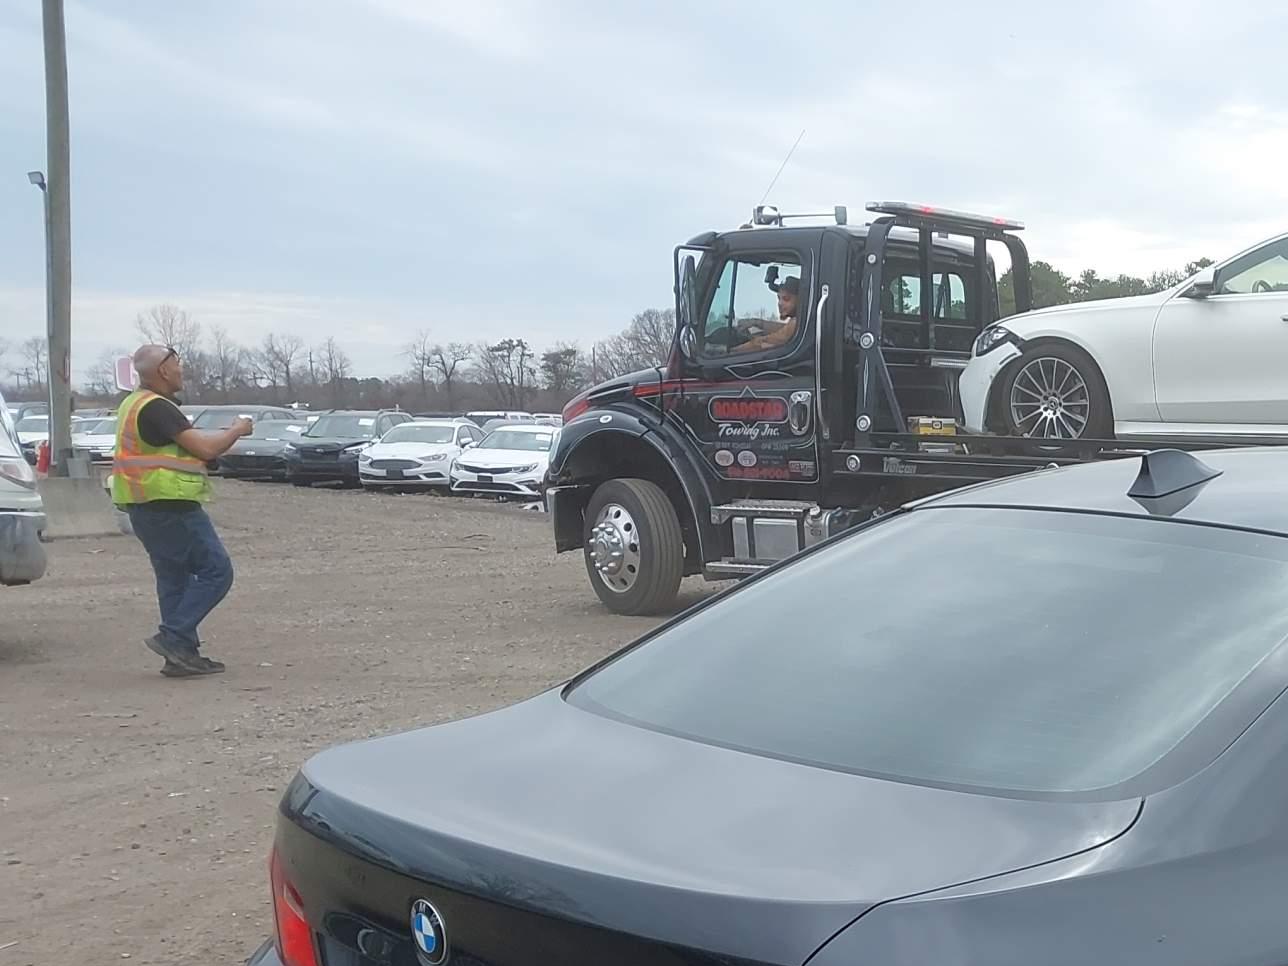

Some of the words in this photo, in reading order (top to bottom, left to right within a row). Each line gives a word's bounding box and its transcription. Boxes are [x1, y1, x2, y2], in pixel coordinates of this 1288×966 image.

[718, 424, 760, 440] Towing
[761, 424, 780, 436] Inc.
[883, 456, 917, 474] Vulcan
